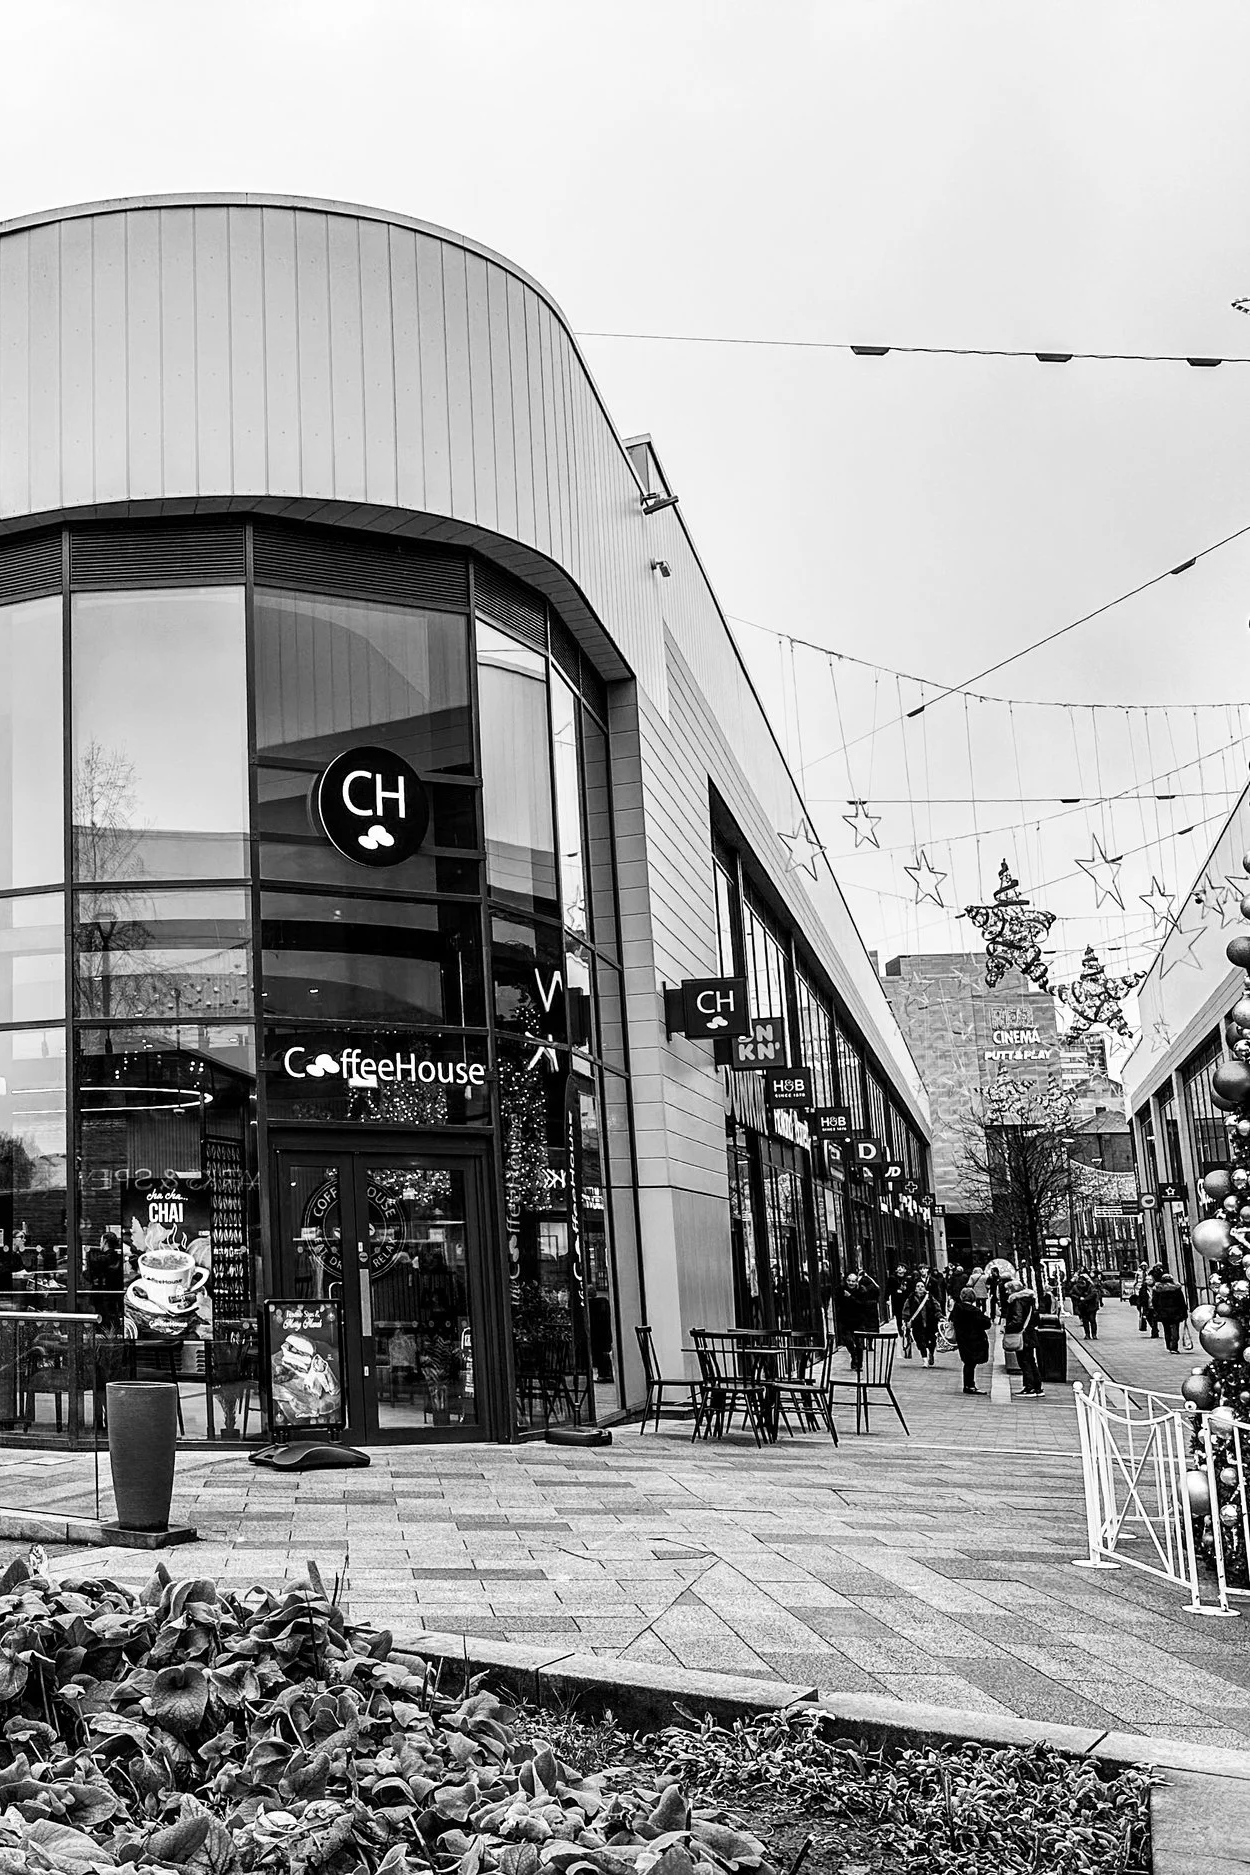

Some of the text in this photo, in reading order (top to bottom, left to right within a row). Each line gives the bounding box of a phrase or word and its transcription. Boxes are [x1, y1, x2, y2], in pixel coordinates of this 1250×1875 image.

[342, 769, 406, 819] CH
[696, 990, 735, 1014] CH
[992, 1029, 1041, 1045] CINEMA
[773, 1079, 805, 1092] H&B
[820, 1115, 847, 1127] H&B
[857, 1142, 877, 1160] D
[149, 1203, 184, 1223] CHAI
